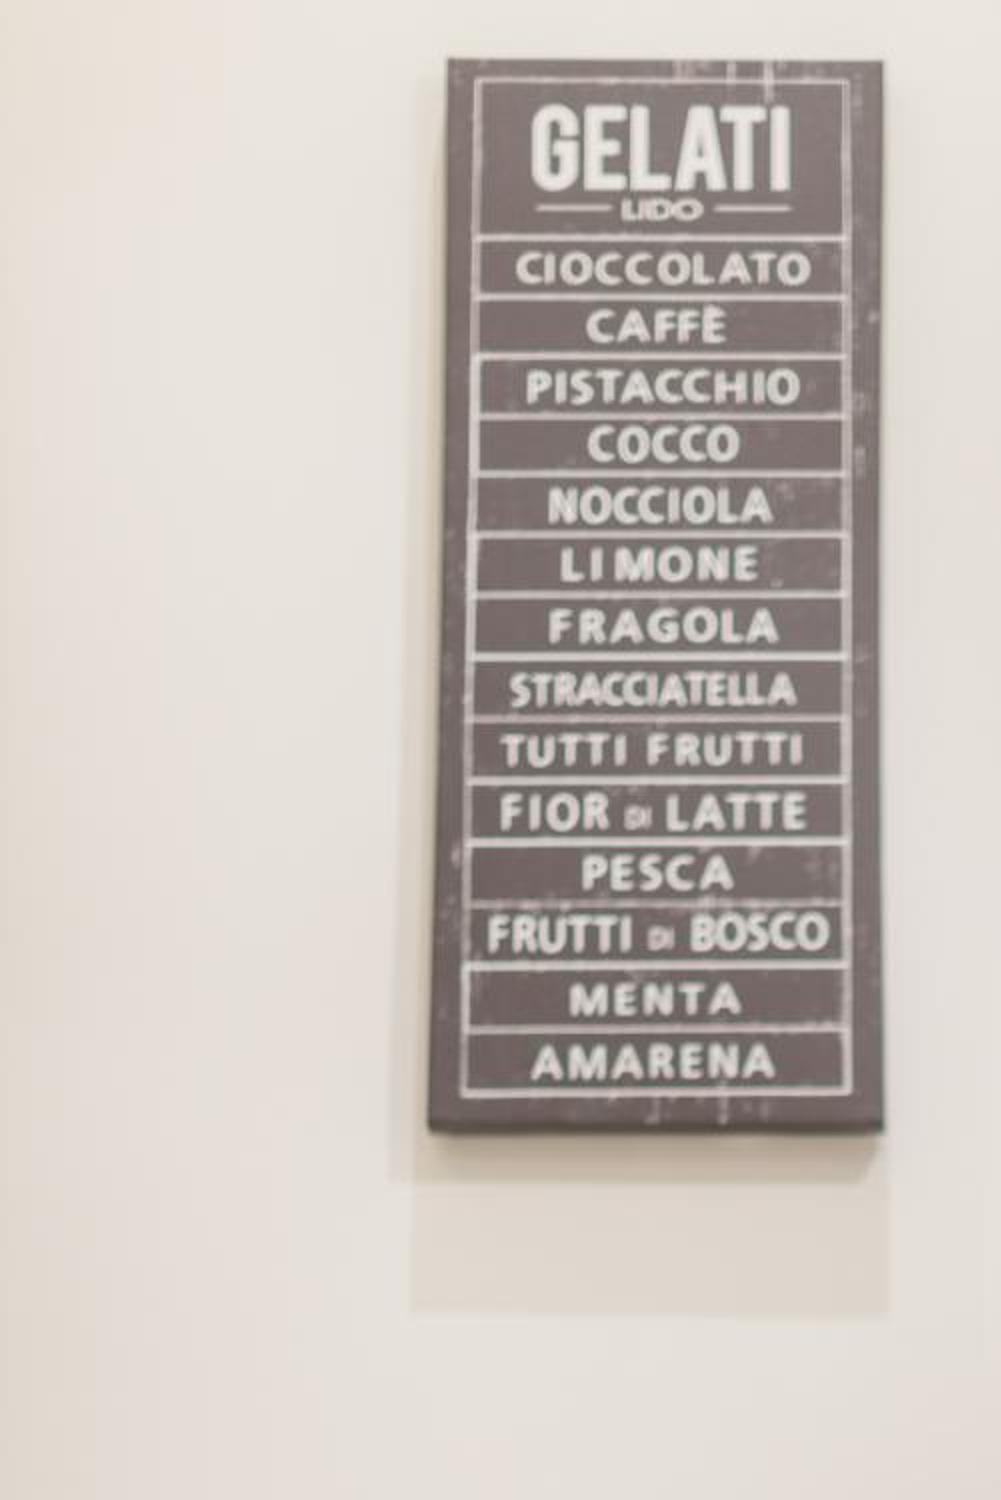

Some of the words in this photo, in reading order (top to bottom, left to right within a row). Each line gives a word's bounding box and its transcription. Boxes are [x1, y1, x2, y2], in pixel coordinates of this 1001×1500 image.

[531, 103, 791, 191] GELATI
[621, 199, 704, 221] LIDO
[515, 252, 812, 286] CIOCCOLATO
[586, 305, 728, 344] CAFFÈ
[525, 369, 800, 405] PISTACCHIO
[586, 425, 741, 462] COCCO
[548, 486, 774, 525] NOCCIOLA
[560, 546, 758, 583] LIMONE
[548, 609, 779, 645] FRAGOLA
[509, 672, 798, 708] STRACCIATELLA
[500, 733, 628, 768] TUTTI
[646, 732, 802, 766] FRUTTI
[500, 793, 610, 832] FIOR
[624, 806, 653, 830] DI
[665, 793, 807, 831] LATTE
[582, 854, 734, 891] PESCA
[487, 915, 632, 954] FRUTTI
[647, 927, 675, 951] DI
[689, 913, 830, 952] BOSCO
[568, 982, 742, 1017] MENTA
[530, 1043, 777, 1080] AMARENA
